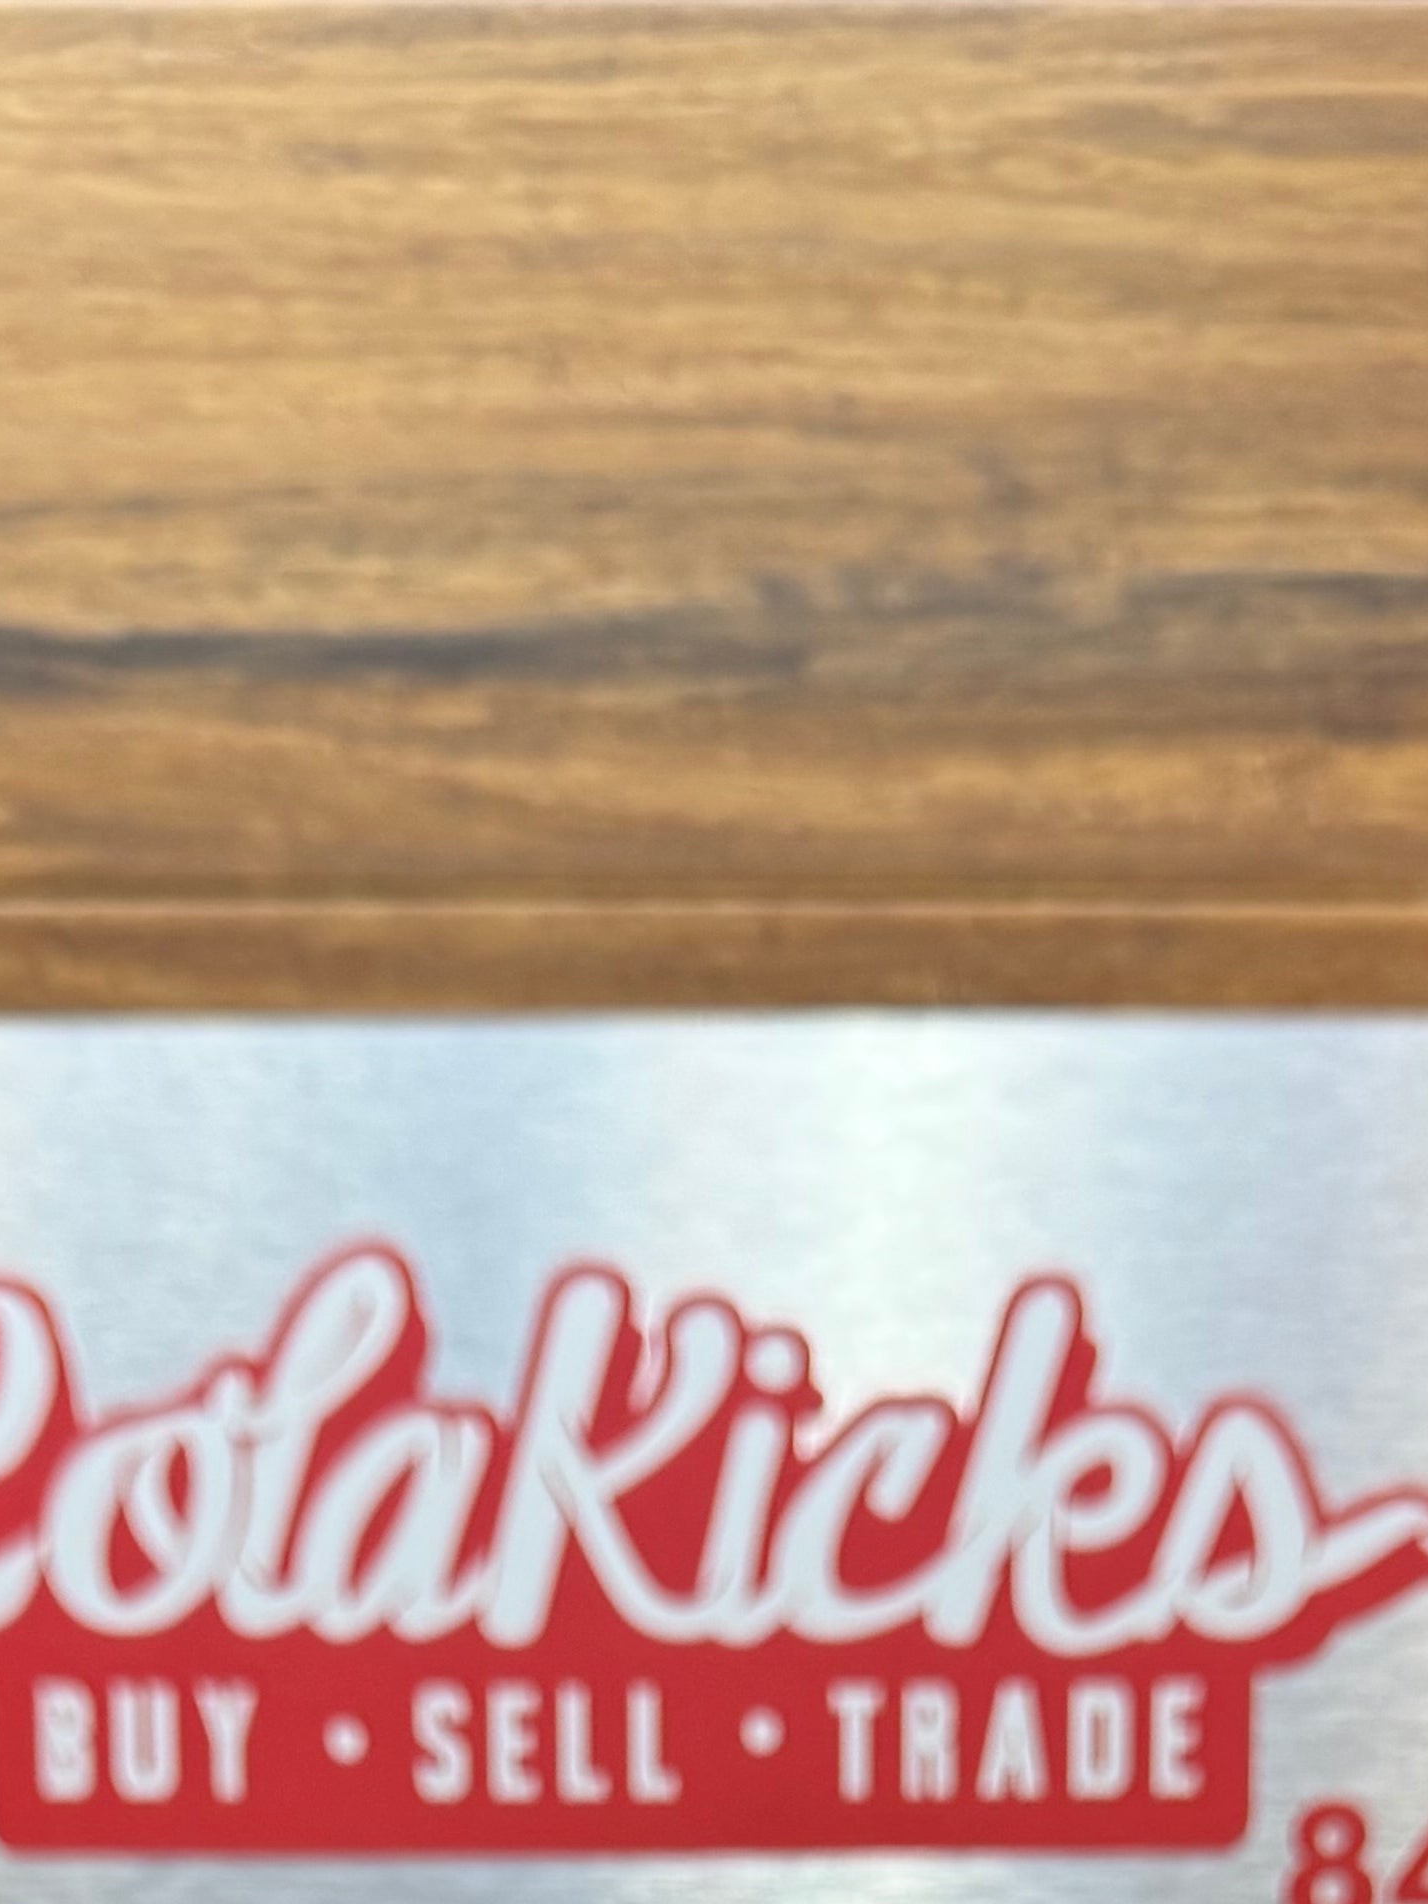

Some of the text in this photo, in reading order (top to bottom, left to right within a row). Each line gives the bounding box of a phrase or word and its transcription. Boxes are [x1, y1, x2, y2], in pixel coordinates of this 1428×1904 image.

[32, 1678, 1206, 1804] BUY SELL TRADE
